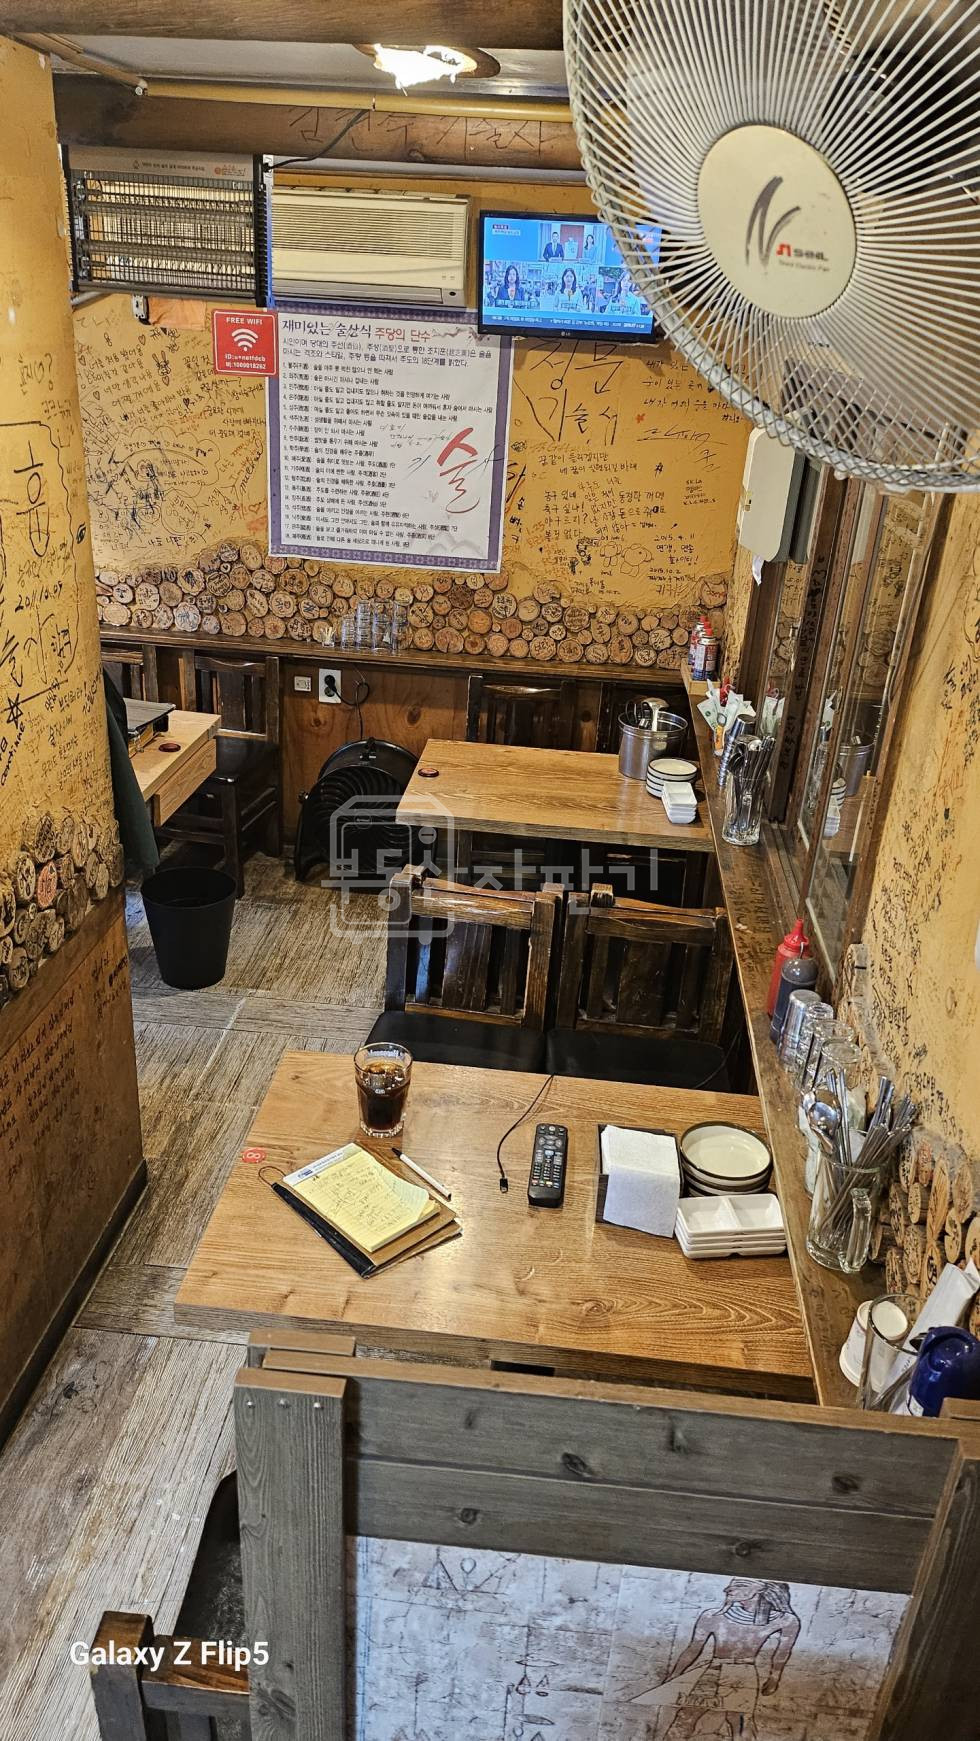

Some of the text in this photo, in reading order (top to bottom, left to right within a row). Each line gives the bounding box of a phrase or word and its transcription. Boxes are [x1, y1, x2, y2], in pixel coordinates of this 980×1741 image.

[282, 319, 432, 343] 재미있는 술상식 주당의 단수
